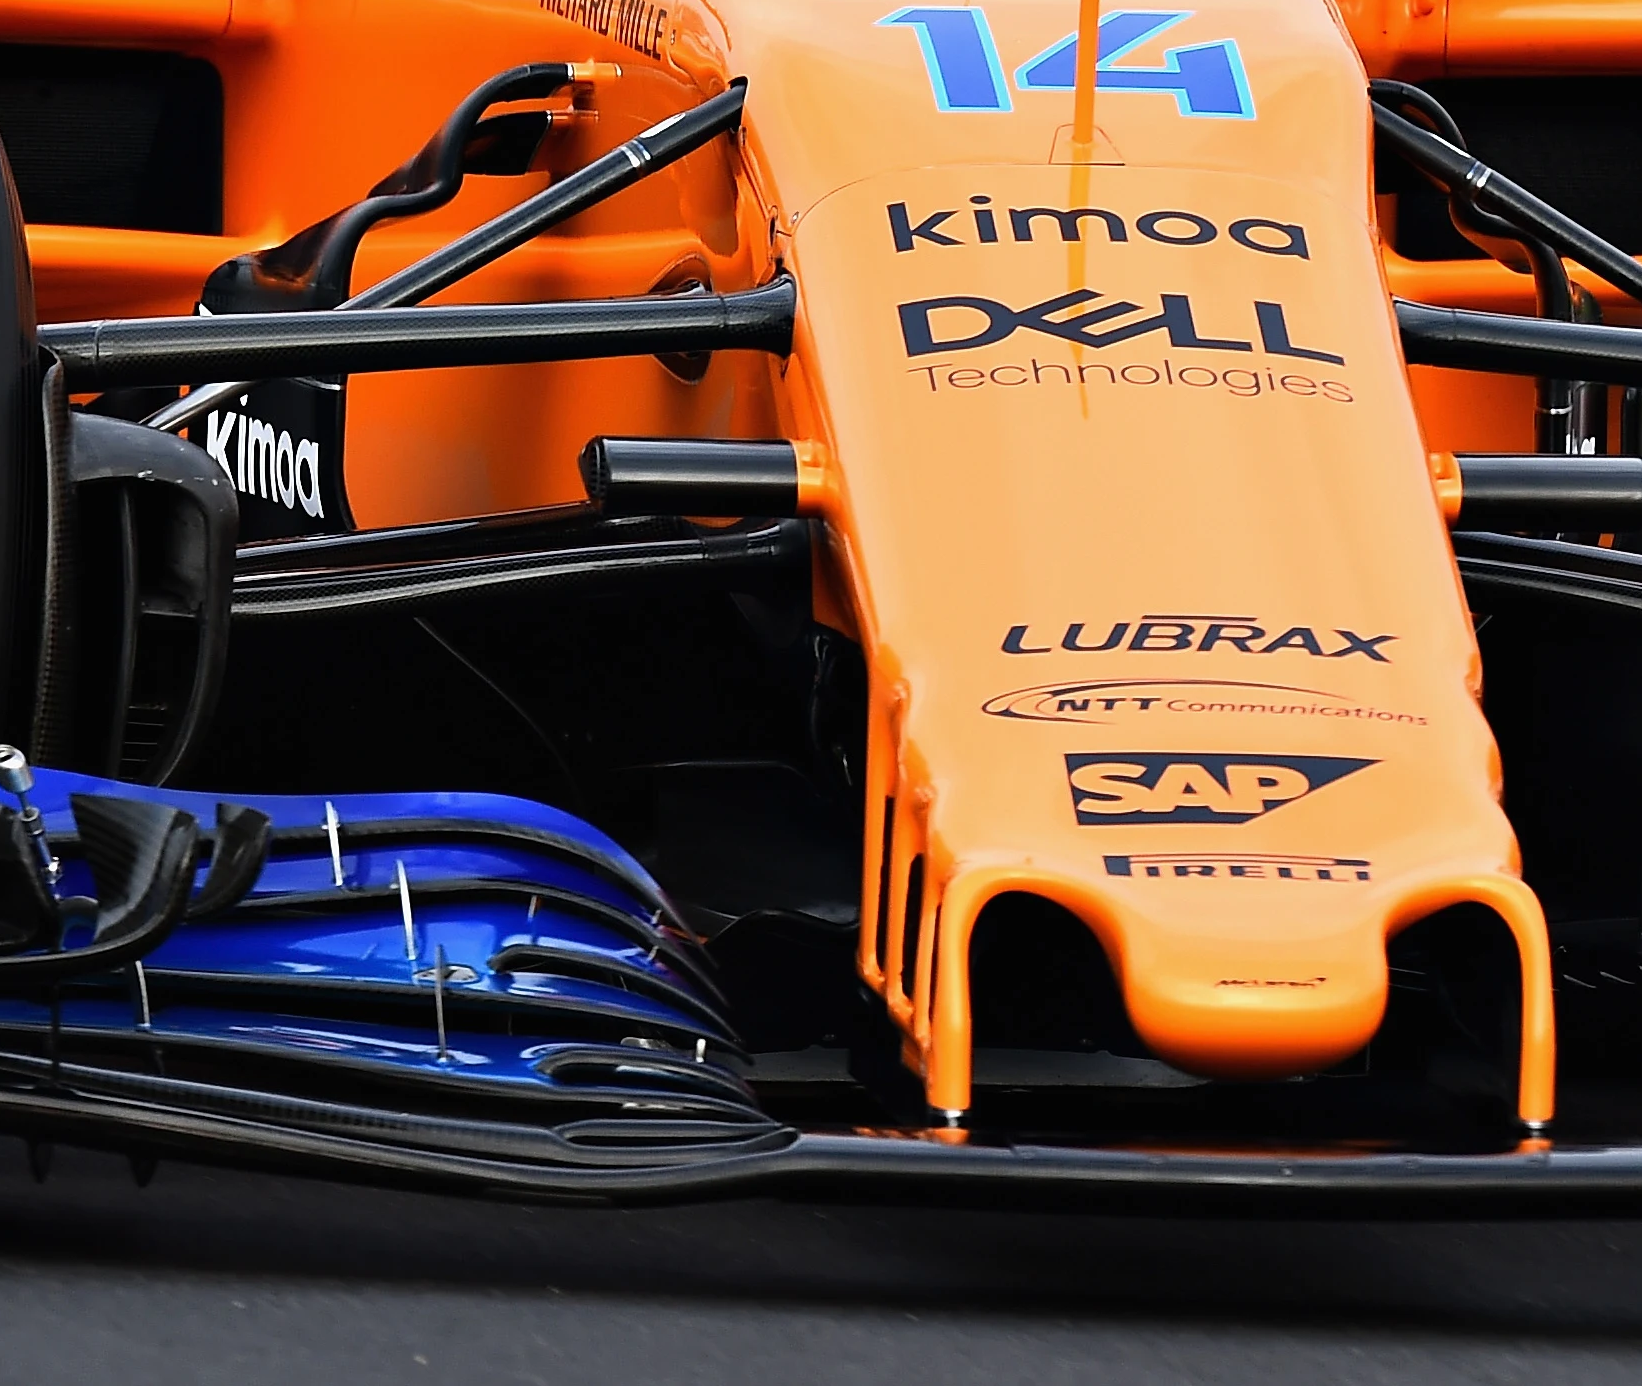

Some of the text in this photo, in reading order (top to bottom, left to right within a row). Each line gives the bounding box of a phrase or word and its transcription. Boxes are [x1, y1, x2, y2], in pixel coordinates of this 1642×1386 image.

[874, 5, 1257, 120] 14
[887, 195, 1310, 260] kimoa
[897, 288, 1346, 366] DELL
[906, 358, 1354, 403] Technologies
[207, 394, 324, 518] kimoa
[1000, 615, 1400, 663] LUBRAX
[1056, 698, 1429, 727] NTT Communications
[1068, 762, 1311, 815] SAP
[1102, 854, 1372, 882] PIRELLI
